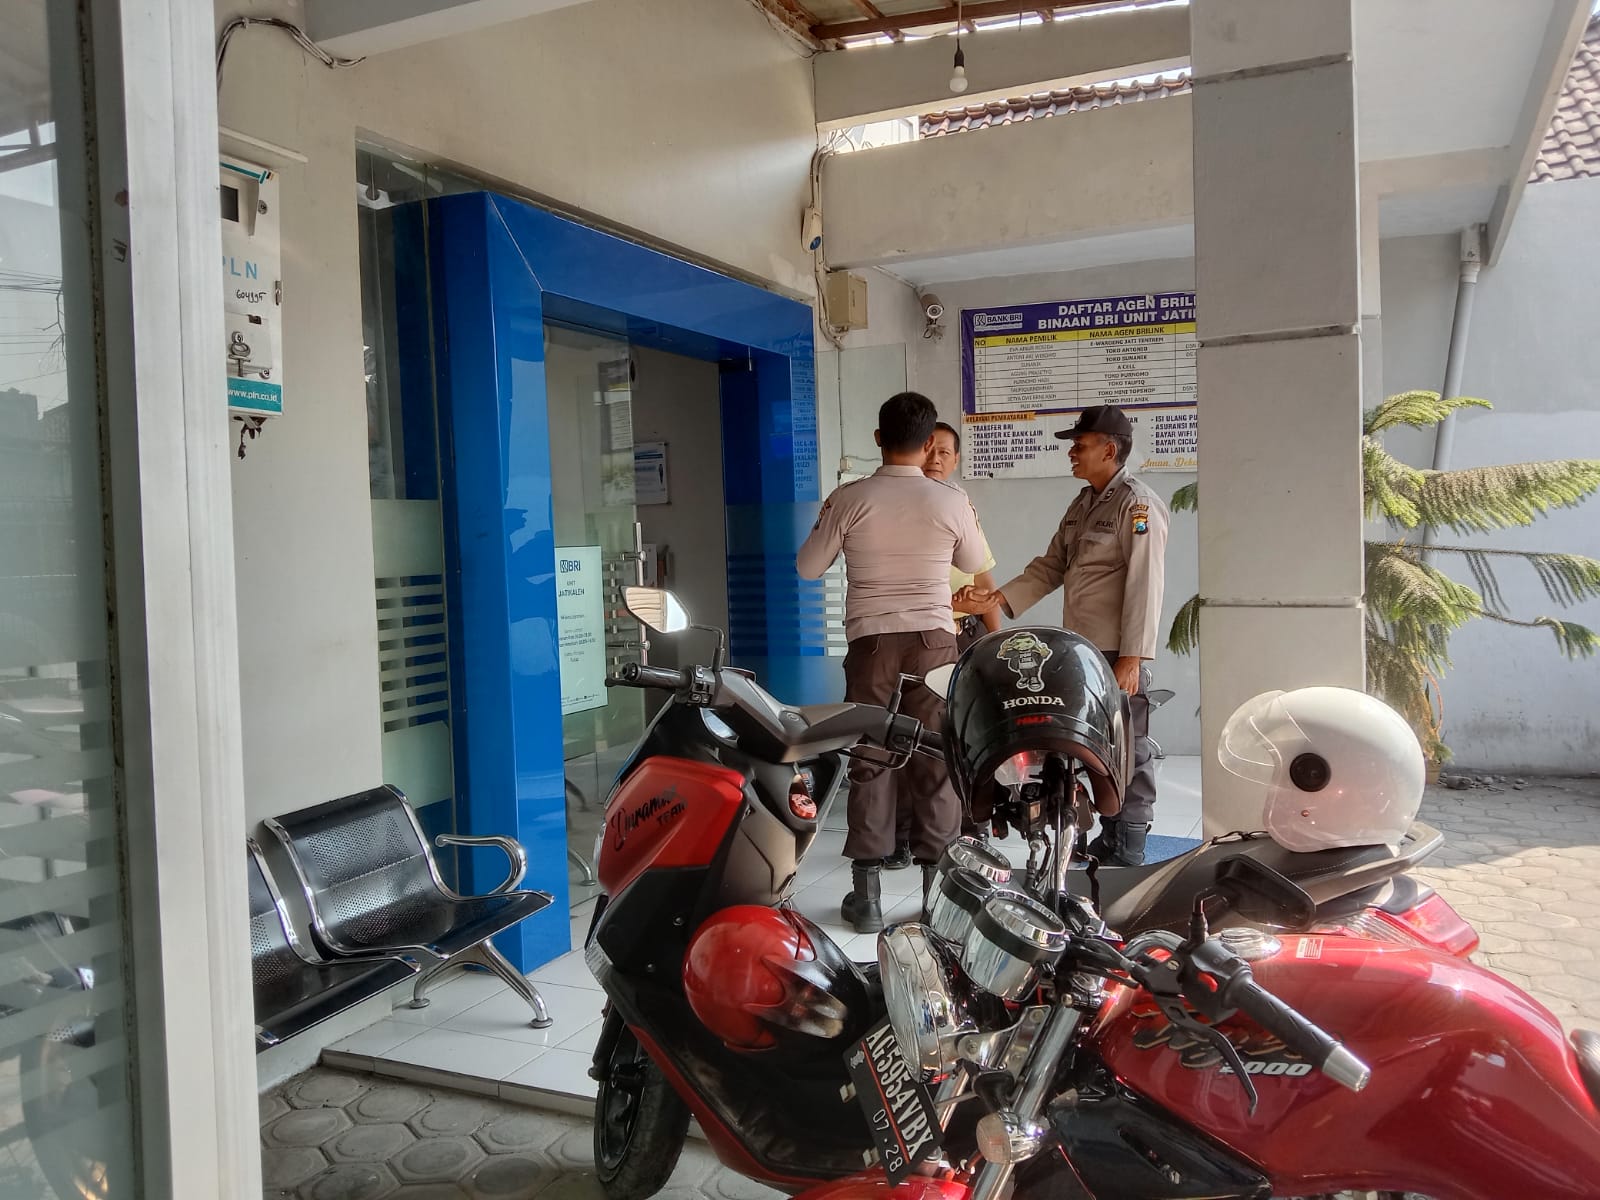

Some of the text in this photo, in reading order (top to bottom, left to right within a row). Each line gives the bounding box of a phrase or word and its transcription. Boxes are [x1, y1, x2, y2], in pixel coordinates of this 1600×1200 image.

[223, 256, 257, 280] LN
[1059, 302, 1112, 316] DAFTAR
[1116, 295, 1155, 311] AGEN
[987, 313, 1022, 323] BANK BRI
[1038, 316, 1090, 329] BINAAN
[1095, 314, 1118, 325] BRI
[1123, 312, 1157, 323] UNIT
[1089, 326, 1165, 338] NAMA AGEN BRILINK
[1006, 334, 1057, 344] NAMA PEMILIK
[973, 424, 1001, 432] TRANSFER
[569, 560, 580, 571] BRI
[558, 587, 585, 597] JATIKALEN
[1002, 695, 1065, 710] HONDA
